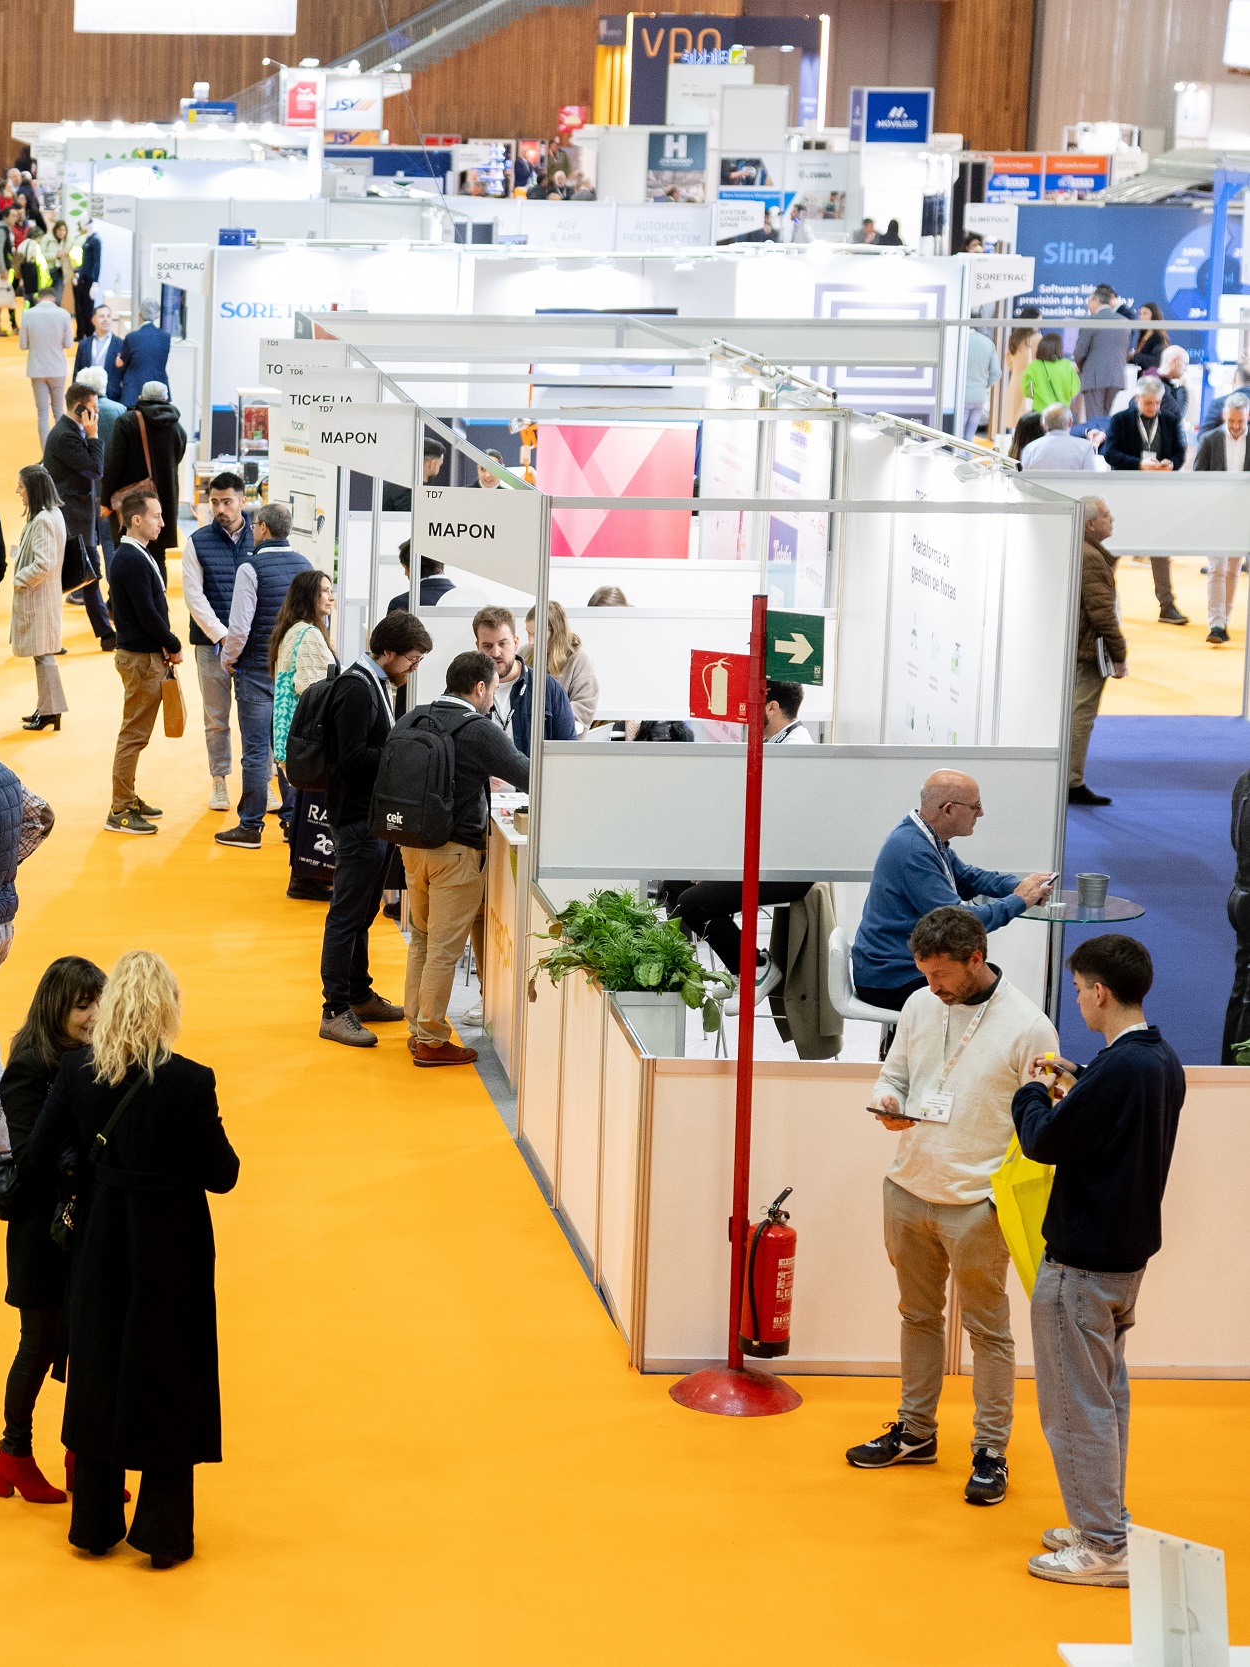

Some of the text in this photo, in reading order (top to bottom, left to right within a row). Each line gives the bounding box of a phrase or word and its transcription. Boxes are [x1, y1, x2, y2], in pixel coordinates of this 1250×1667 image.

[556, 220, 578, 230] AGV
[634, 220, 691, 231] AUTOMATIC
[622, 233, 701, 245] PICKING SYSTEM
[1043, 241, 1115, 265] Slim4
[157, 262, 206, 270] SORETRAC
[976, 272, 1027, 282] SORETRAC
[1039, 283, 1079, 295] Software
[1019, 295, 1060, 306] previsión
[1062, 295, 1073, 305] de
[321, 431, 378, 445] MAPON
[426, 490, 444, 499] TD7
[428, 521, 496, 540] MAPON
[386, 811, 404, 825] ceit
